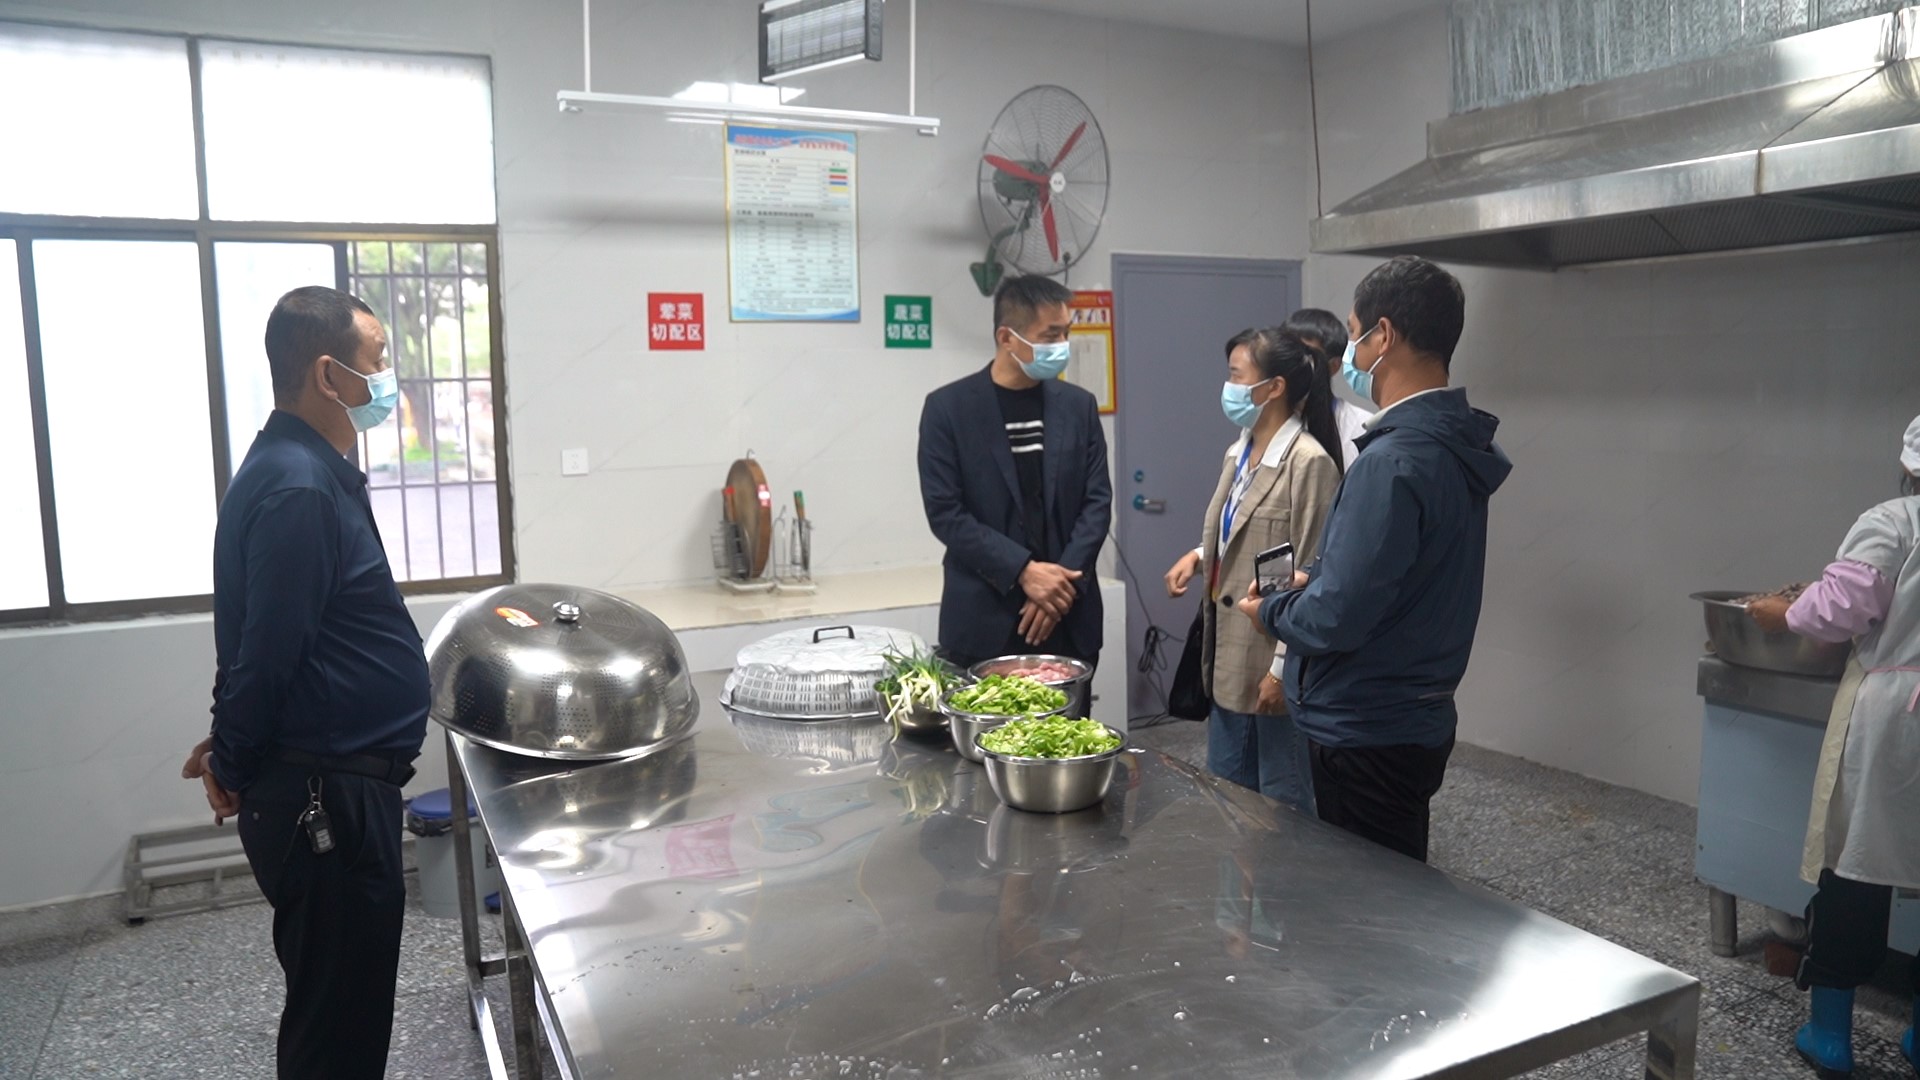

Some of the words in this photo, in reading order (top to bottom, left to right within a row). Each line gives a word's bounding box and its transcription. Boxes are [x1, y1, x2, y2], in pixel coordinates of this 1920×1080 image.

[895, 304, 923, 321] 蔬菜
[652, 323, 702, 341] 切配区
[888, 324, 930, 341] 切配区
